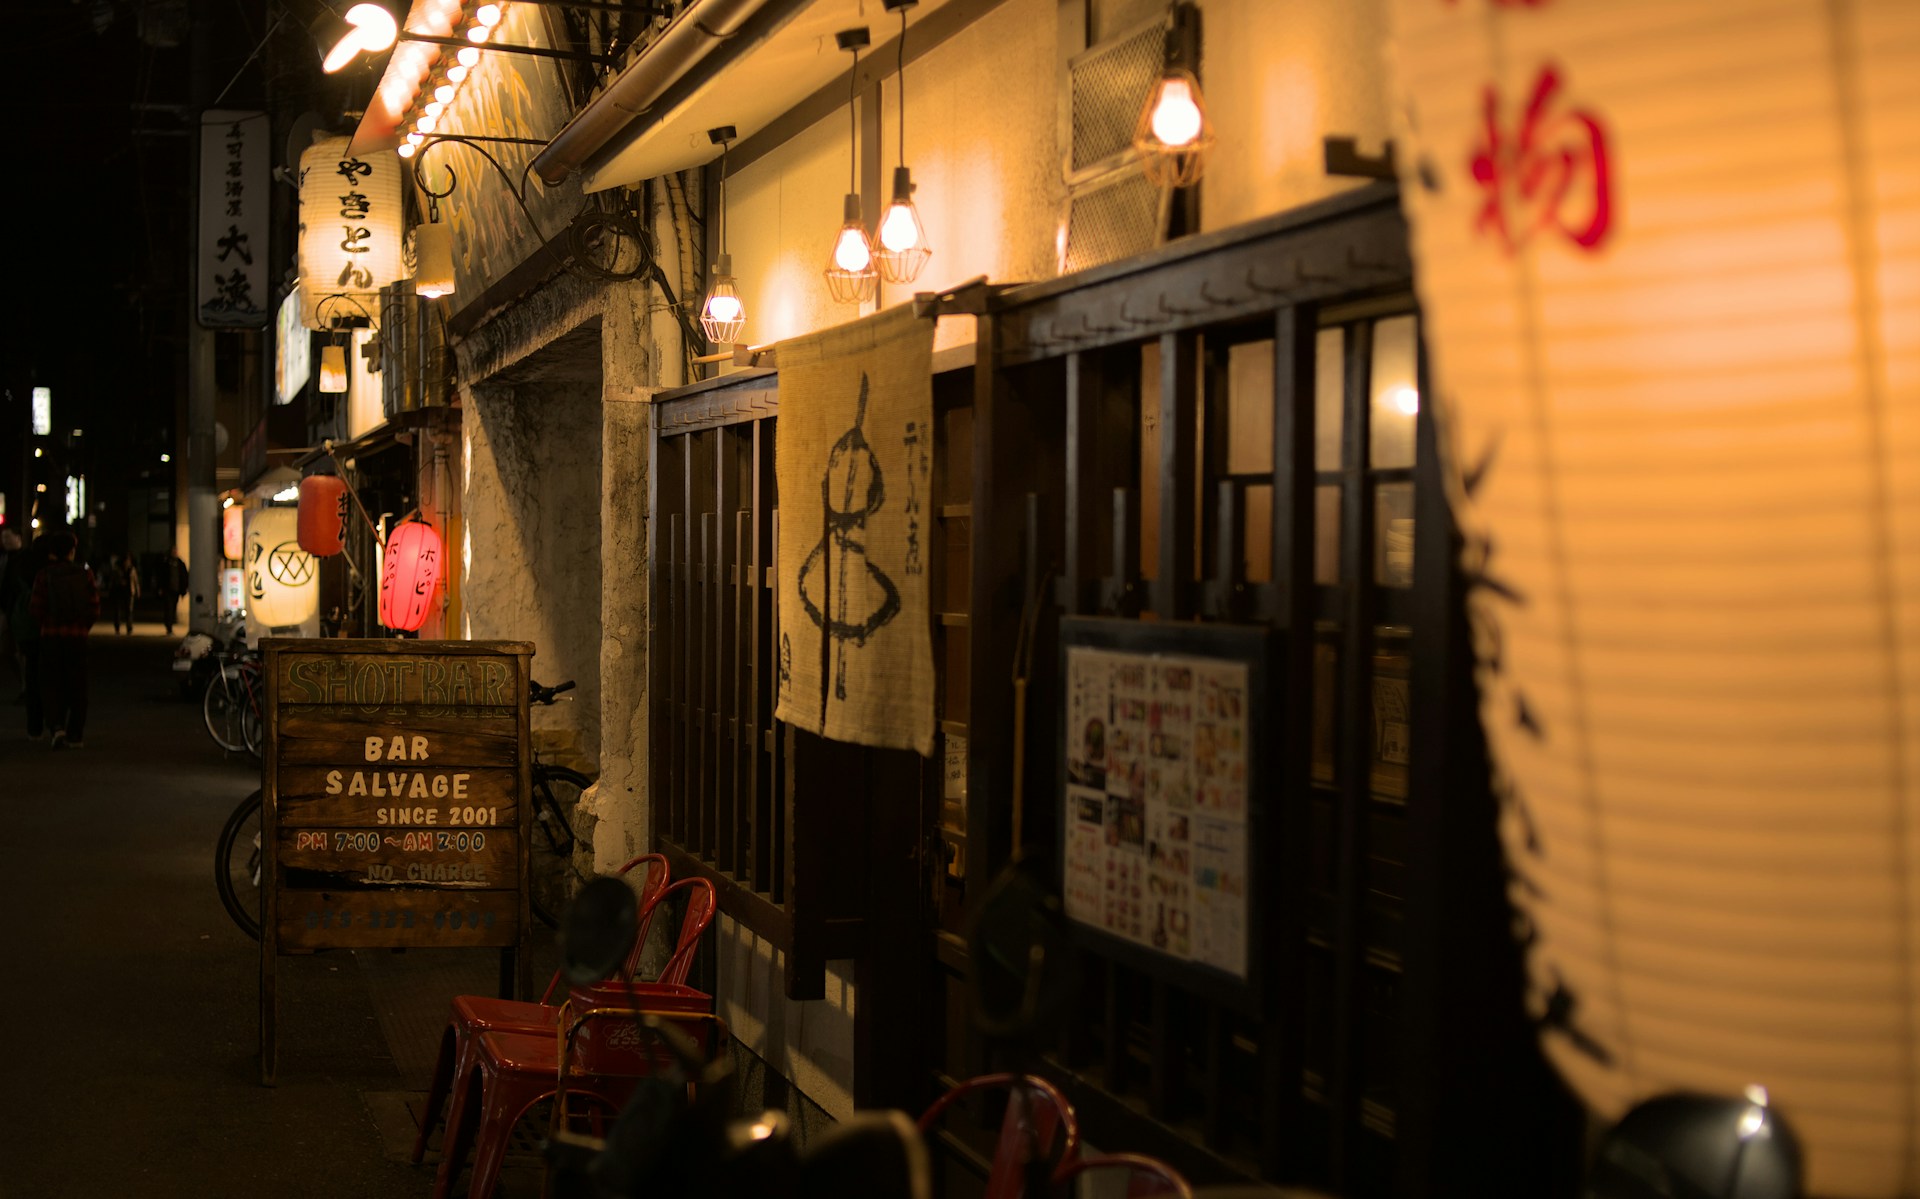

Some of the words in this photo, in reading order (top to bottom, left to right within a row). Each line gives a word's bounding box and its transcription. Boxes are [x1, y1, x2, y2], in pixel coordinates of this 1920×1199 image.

[336, 157, 373, 289] やきとん
[382, 541, 399, 611] ホッピー
[415, 547, 436, 616] ホッピー
[288, 660, 414, 716] SHOT
[417, 660, 511, 719] BAR
[364, 735, 430, 762] BAR
[325, 770, 471, 799] SALVAGE
[377, 807, 438, 825] SINCE
[449, 806, 497, 826] 2001
[296, 832, 328, 851] PM
[335, 832, 380, 852] 7:00
[437, 832, 486, 852] 2:00
[367, 865, 394, 881] NO
[406, 863, 487, 882] CHARGE
